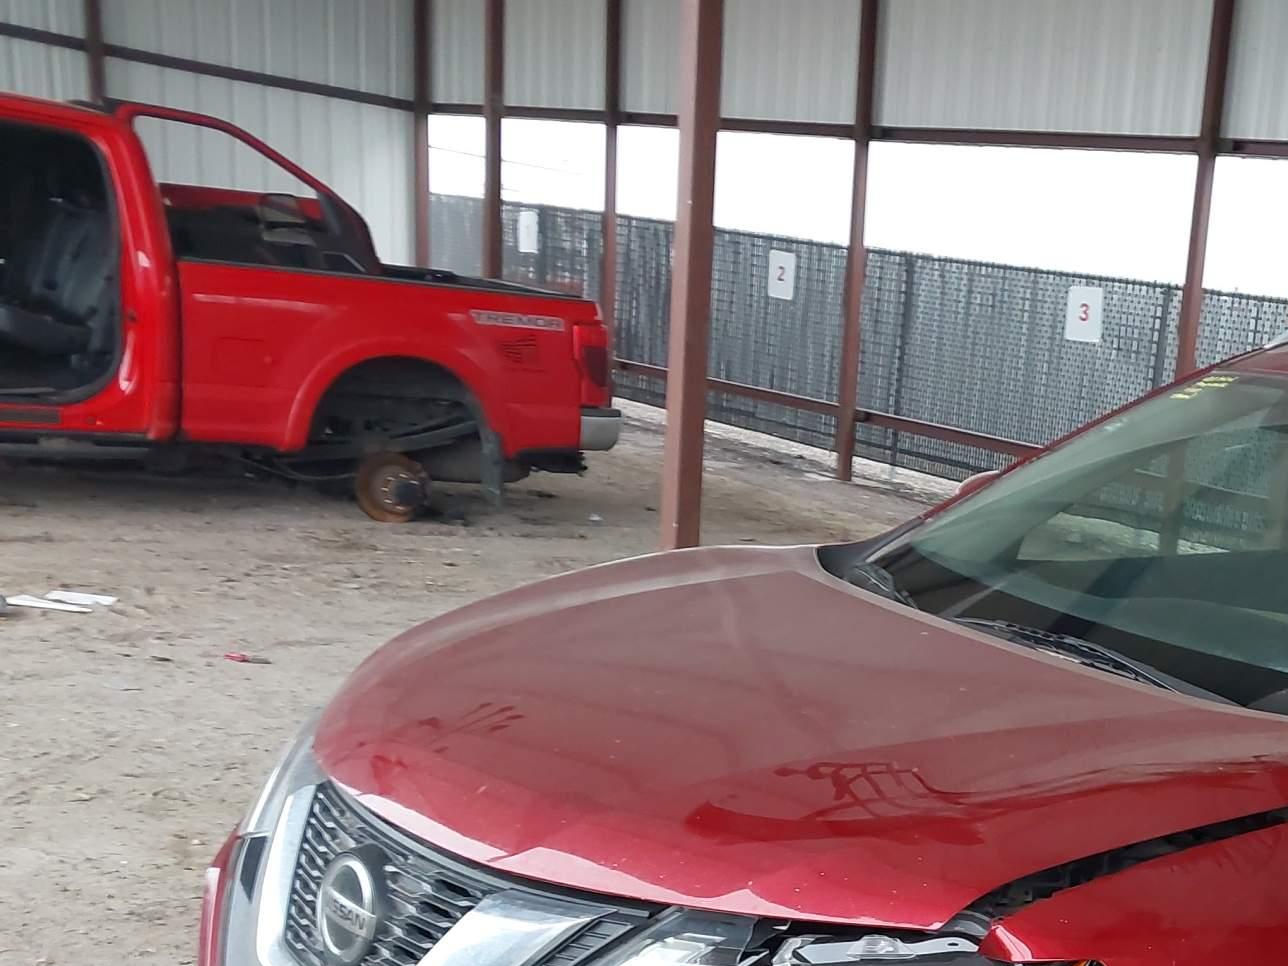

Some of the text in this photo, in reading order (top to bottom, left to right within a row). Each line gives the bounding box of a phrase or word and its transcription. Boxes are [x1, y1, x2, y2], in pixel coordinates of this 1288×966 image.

[777, 265, 786, 283] 2
[471, 309, 565, 331] TREMOR
[1079, 302, 1090, 322] 3
